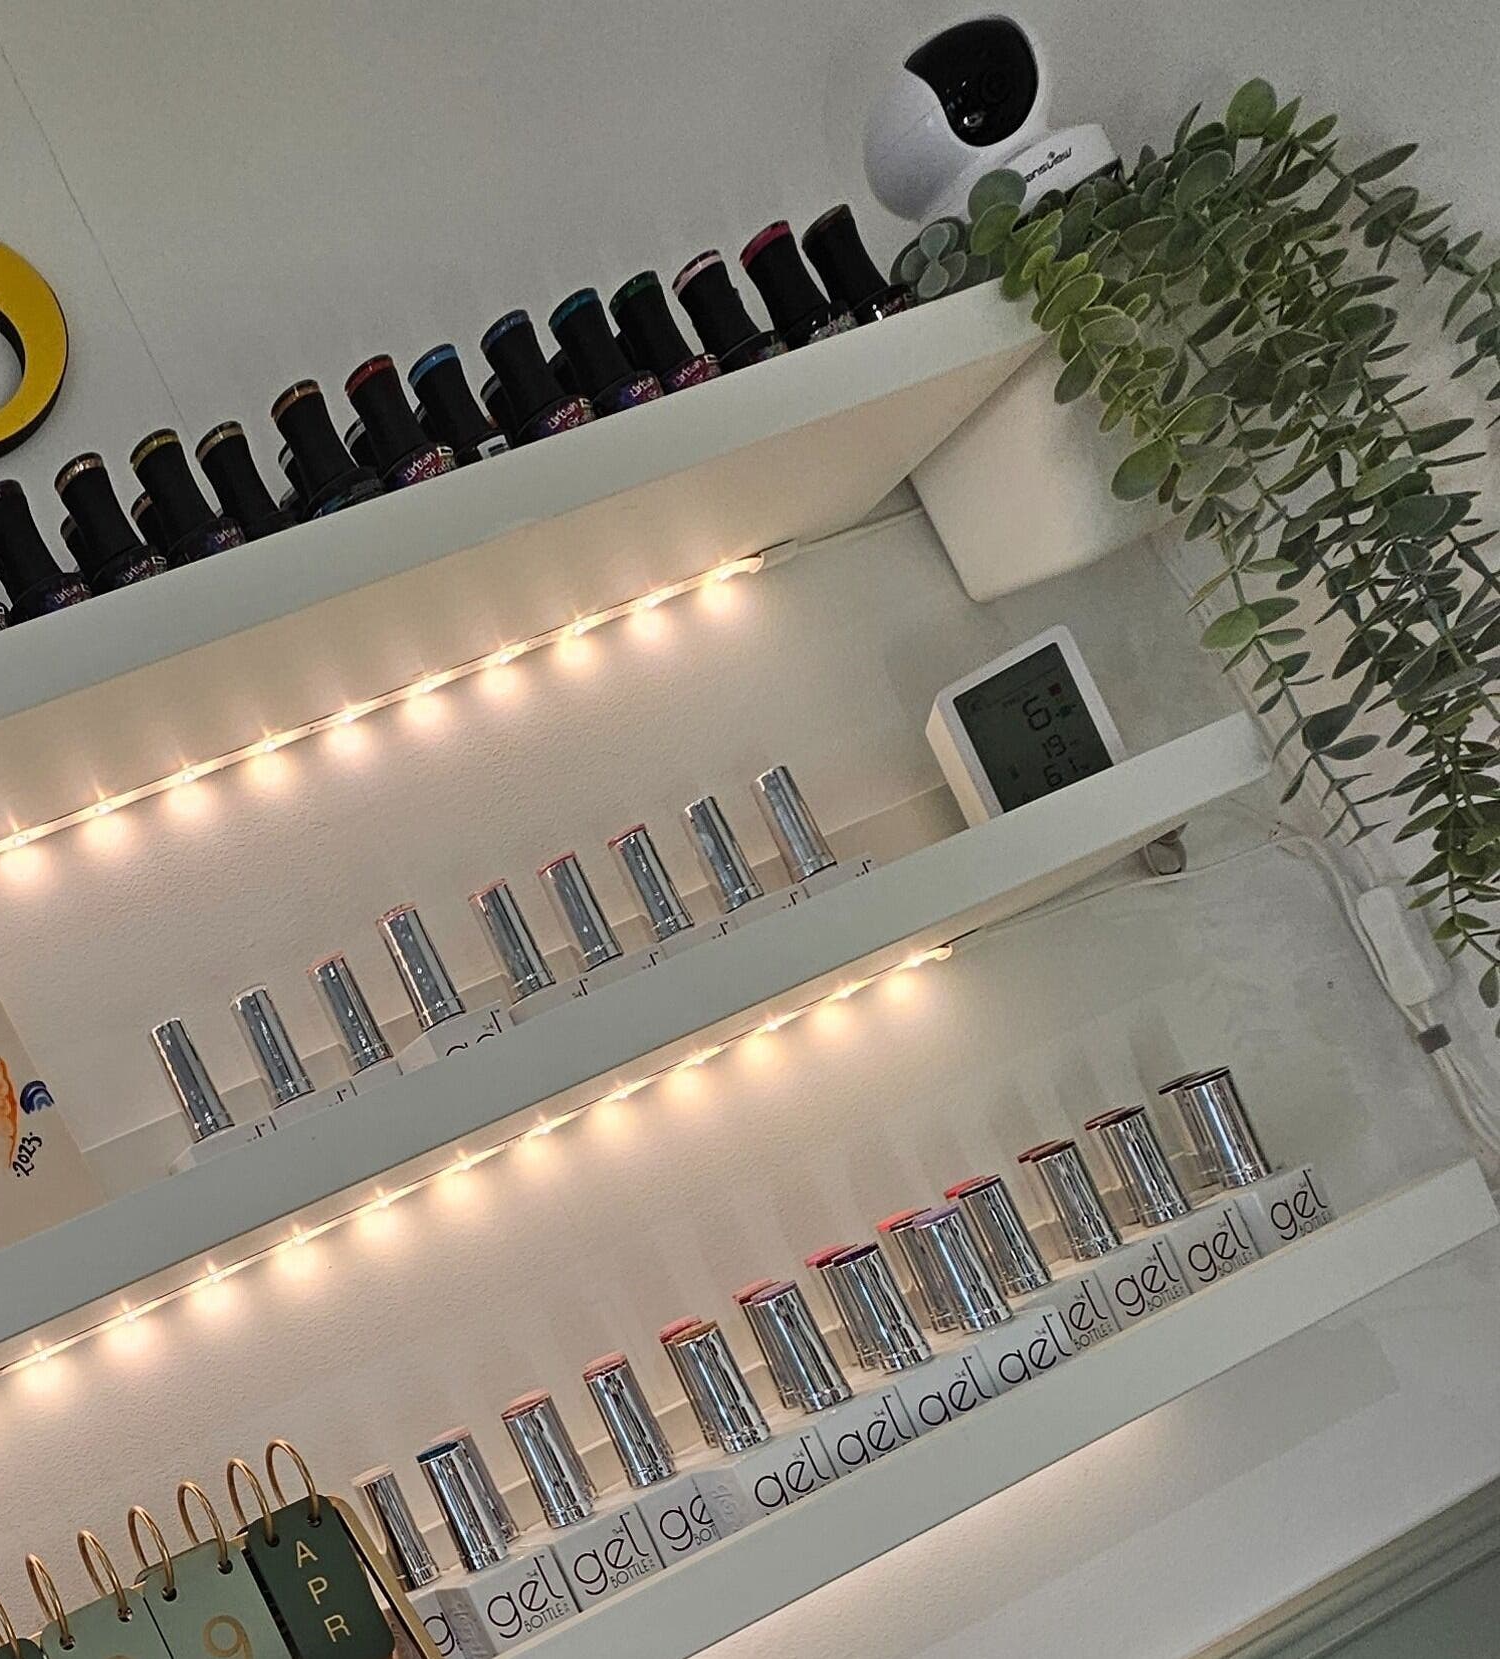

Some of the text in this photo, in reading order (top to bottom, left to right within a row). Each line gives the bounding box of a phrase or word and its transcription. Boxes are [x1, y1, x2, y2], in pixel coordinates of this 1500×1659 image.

[1024, 147, 1072, 182] ansview
[547, 401, 579, 430] Urban
[404, 451, 437, 481] Urban
[1270, 1168, 1328, 1241] gel
[1188, 1209, 1250, 1283] gel
[1114, 1243, 1180, 1317] gel
[573, 1513, 650, 1596] gel
[659, 1494, 714, 1552] ge
[294, 1539, 351, 1644] APR
[487, 1556, 564, 1639] gel
[610, 1559, 650, 1589] BOTTLE
[523, 1602, 565, 1633] BOTTLE
